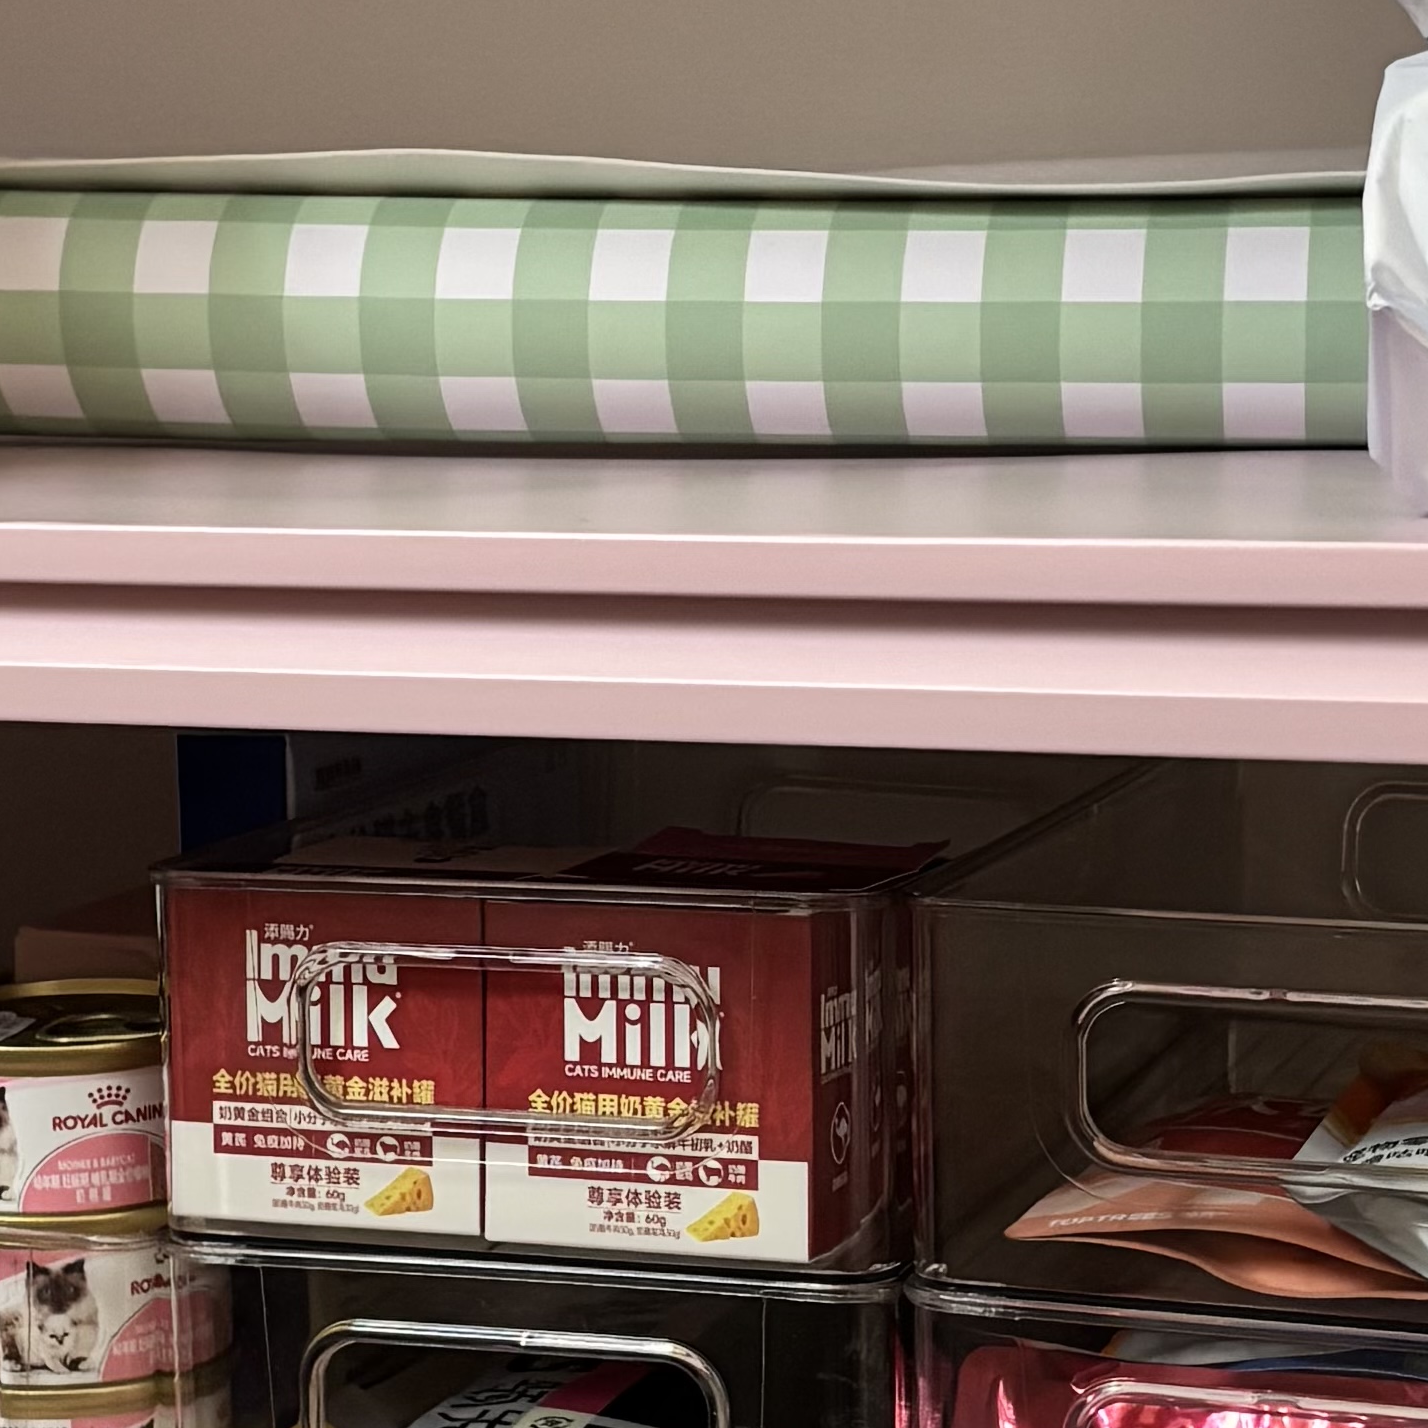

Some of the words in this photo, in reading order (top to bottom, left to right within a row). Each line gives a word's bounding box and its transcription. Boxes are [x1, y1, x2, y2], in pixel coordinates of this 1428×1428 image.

[246, 979, 401, 1050] Milk
[564, 997, 724, 1071] Milk
[248, 1044, 280, 1058] CATS
[336, 1047, 369, 1062] CARE
[565, 1064, 599, 1078] CATS
[601, 1066, 654, 1081] IMMUNE
[657, 1070, 692, 1083] CARE
[52, 1112, 109, 1132] ROYAL
[111, 1102, 164, 1125] CANIN
[270, 1162, 360, 1186] 尊享体验装
[587, 1185, 682, 1211] 尊享体验装
